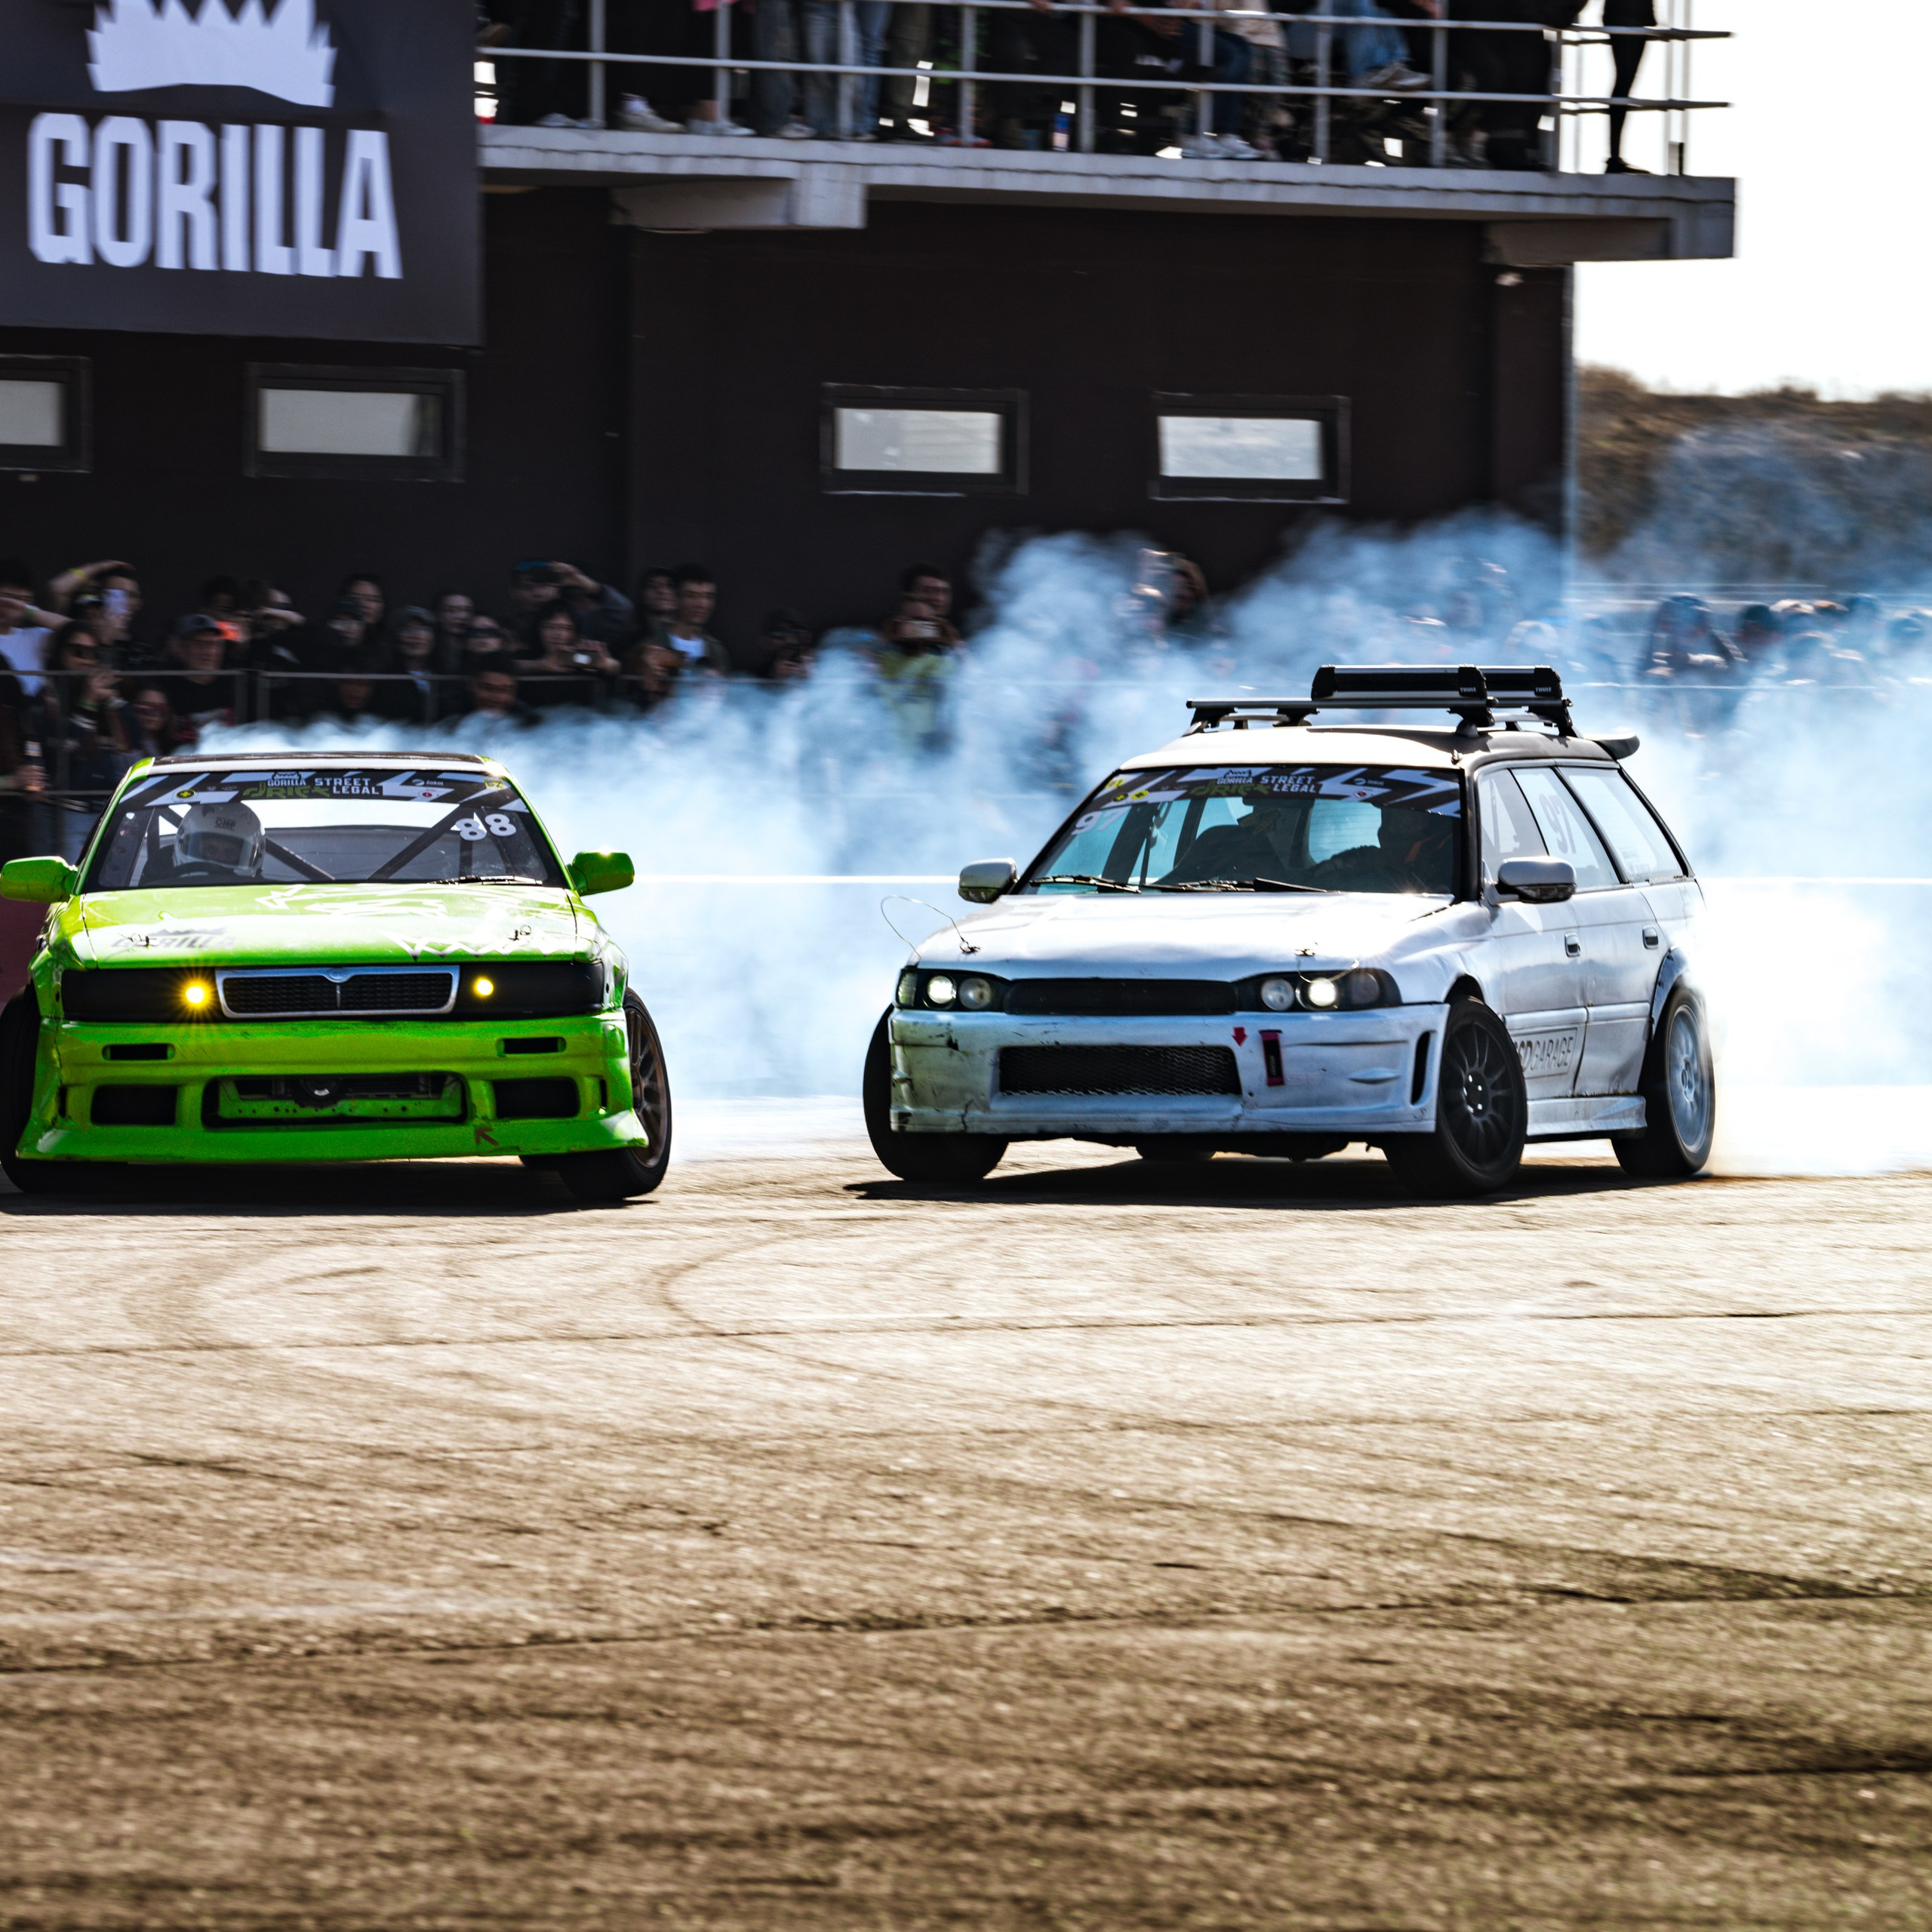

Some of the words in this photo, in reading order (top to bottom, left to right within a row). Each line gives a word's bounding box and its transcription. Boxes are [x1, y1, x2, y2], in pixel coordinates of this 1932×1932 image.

[27, 112, 403, 279] GORILLA
[315, 778, 371, 786] STREET
[1260, 776, 1315, 784] STREET
[1272, 784, 1316, 793] LEGAL
[333, 786, 379, 795] LEGAL
[455, 814, 517, 841] 88
[1071, 807, 1127, 835] 97
[1539, 794, 1577, 854] 97
